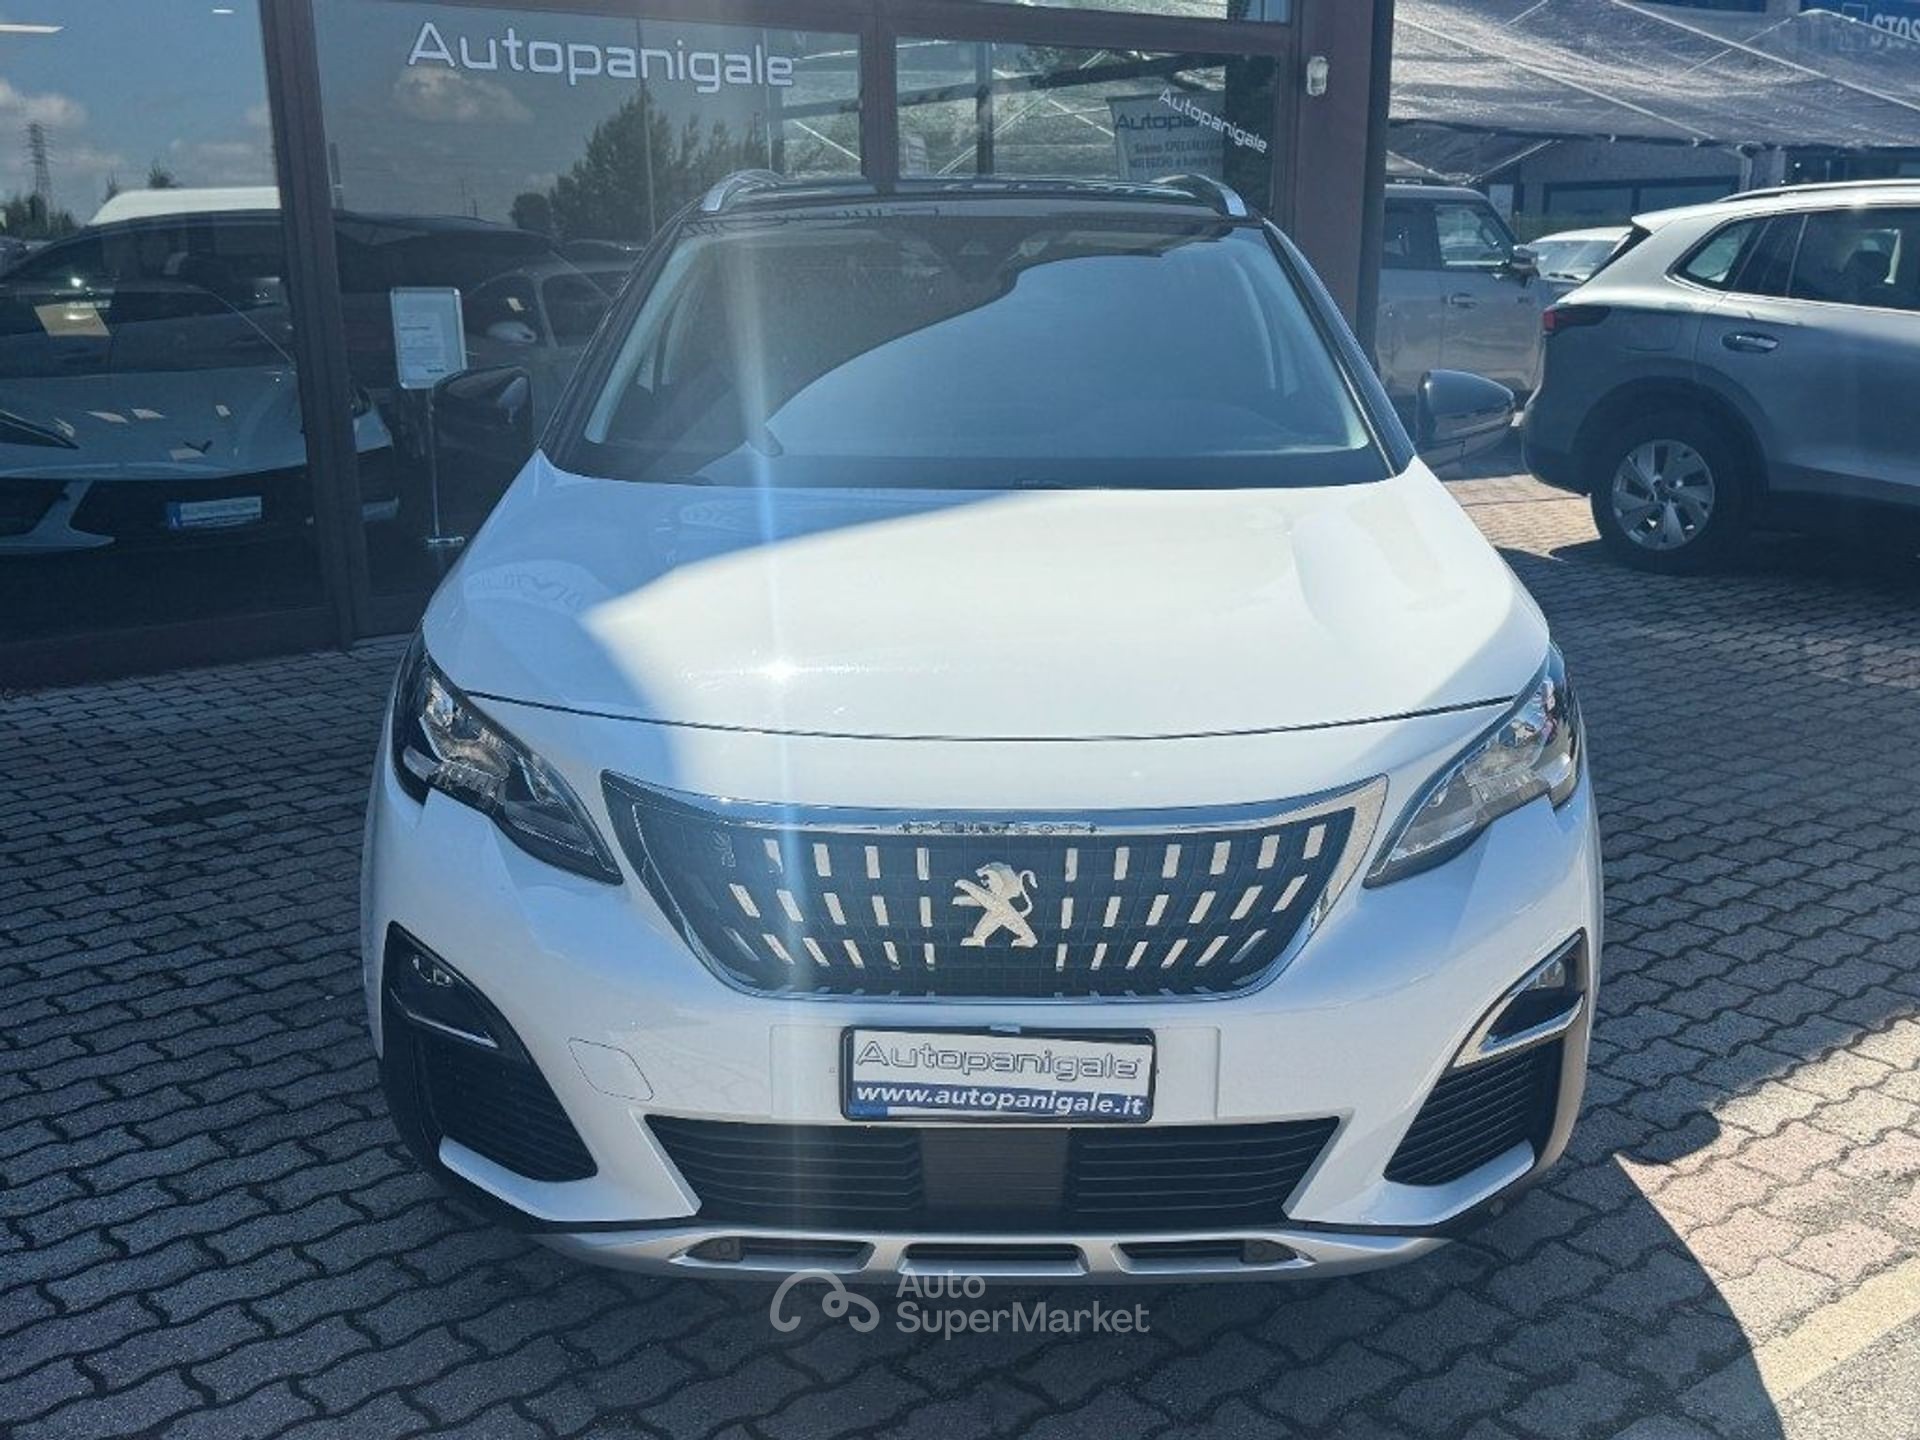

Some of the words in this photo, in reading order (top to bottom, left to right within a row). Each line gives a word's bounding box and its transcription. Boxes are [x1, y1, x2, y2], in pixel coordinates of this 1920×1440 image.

[408, 22, 794, 94] Autopanigale
[1158, 87, 1268, 154] Autopanigale
[856, 1041, 1138, 1082] Autopanigale
[856, 1085, 1143, 1116] www.autopanigale.it
